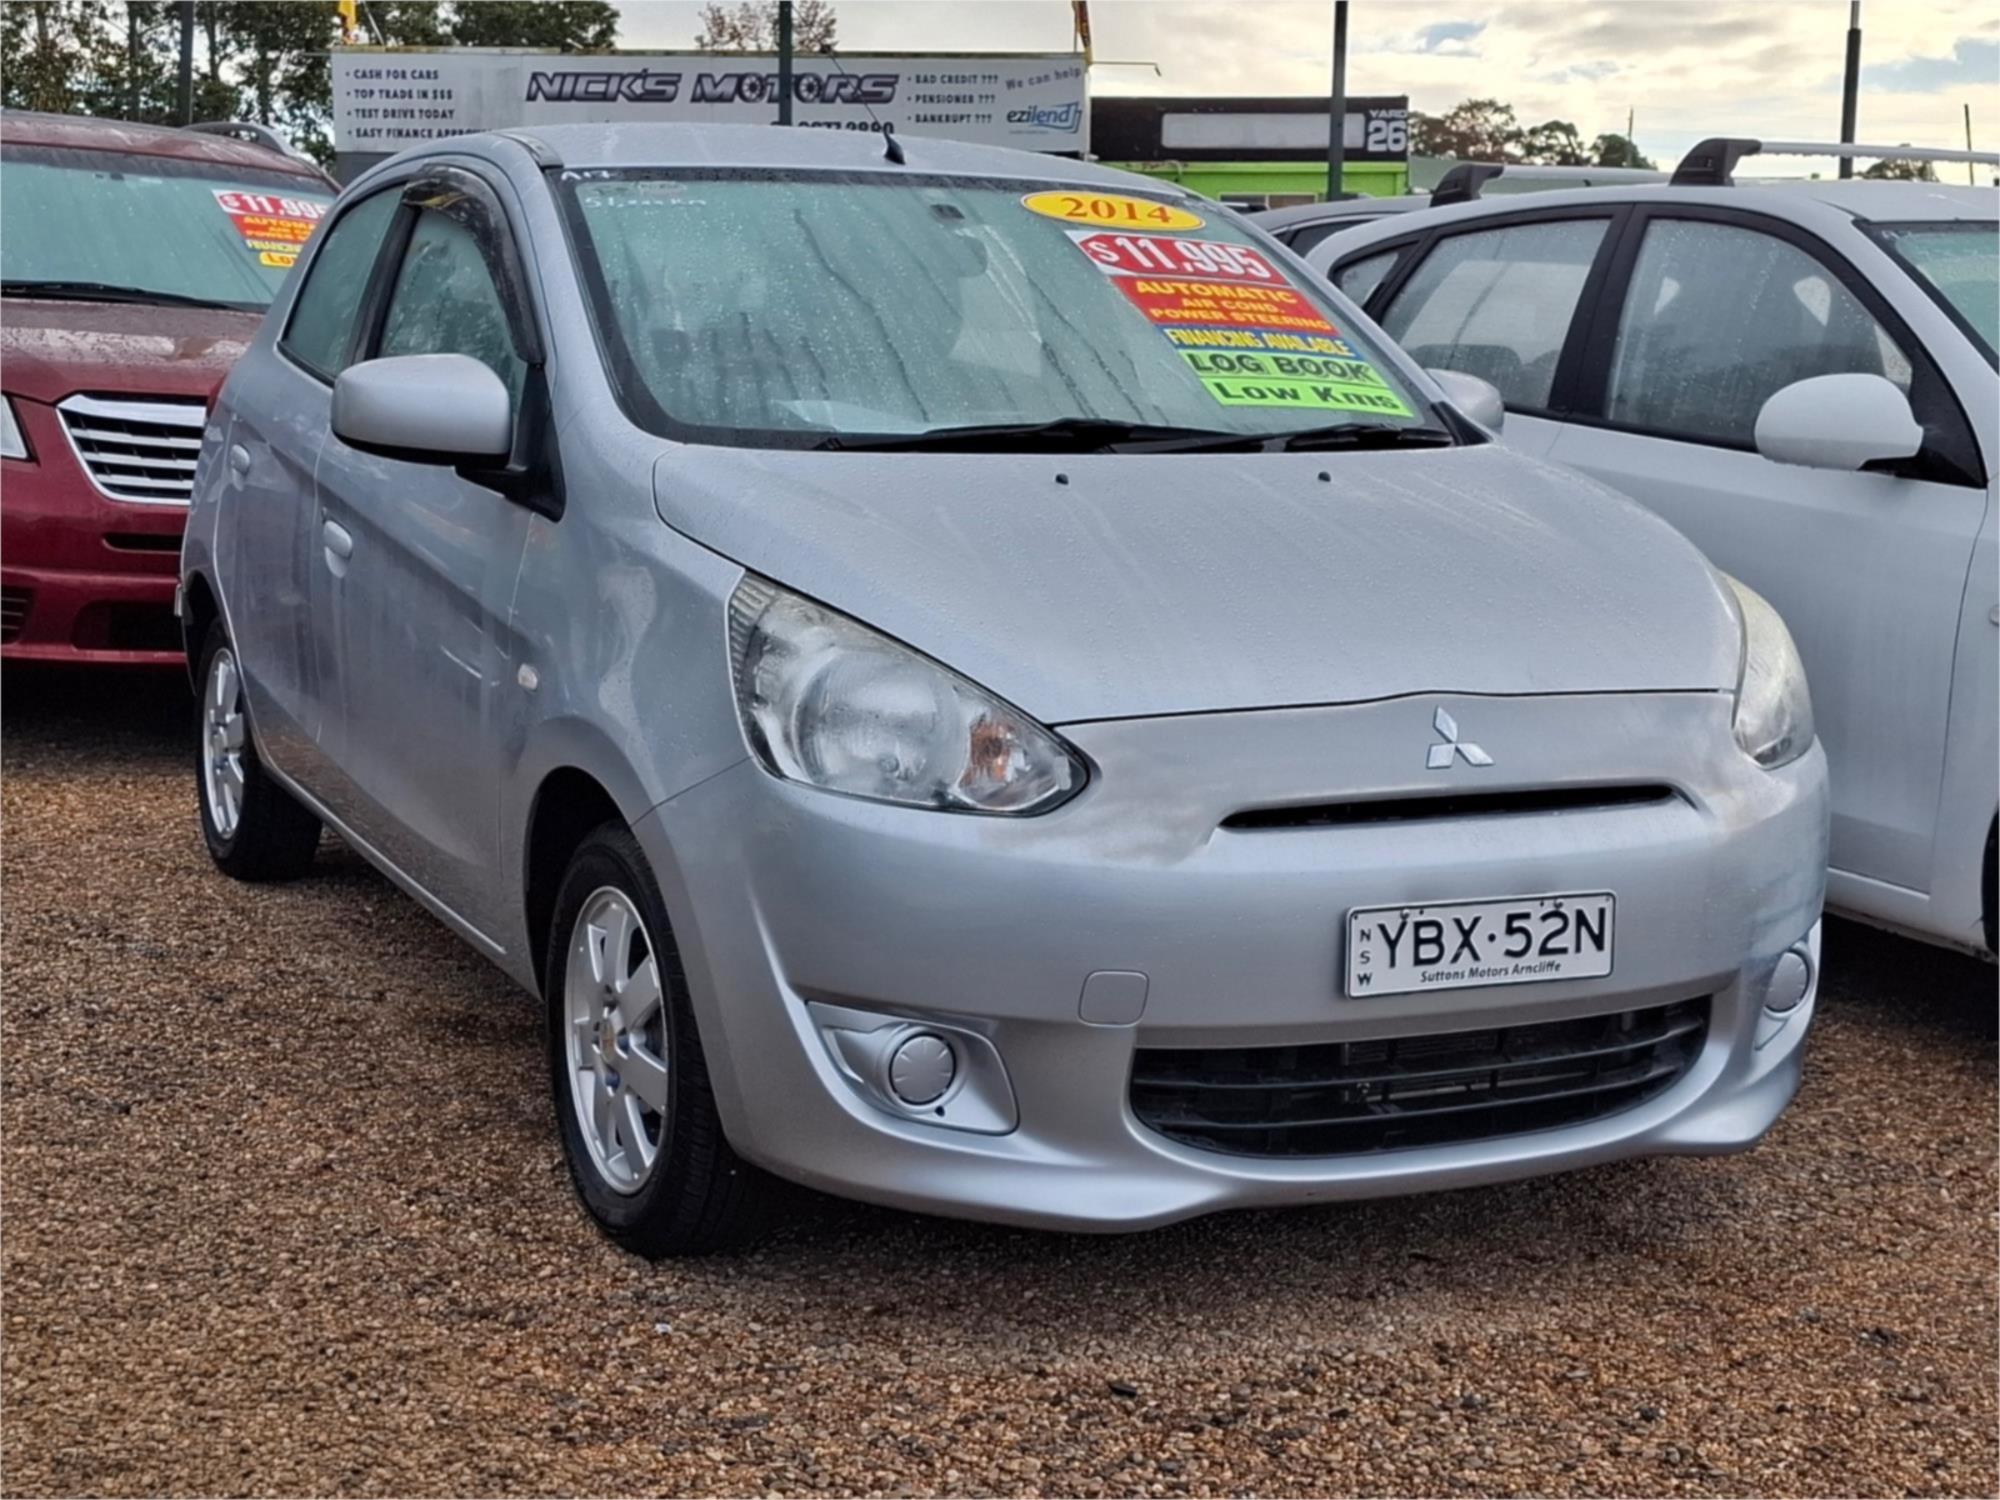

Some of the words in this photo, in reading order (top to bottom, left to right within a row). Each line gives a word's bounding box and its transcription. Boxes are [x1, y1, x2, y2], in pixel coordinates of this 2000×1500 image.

[353, 69, 382, 80] CASH
[386, 69, 407, 80] FOR
[410, 69, 439, 80] CARS
[526, 68, 682, 104] NICK'S
[915, 74, 937, 85] BAD
[940, 74, 978, 85] CREDIT
[981, 74, 998, 85] ???
[1005, 79, 1023, 90] We
[1028, 74, 1051, 86] can
[1054, 67, 1082, 81] help
[353, 89, 375, 99] TOP
[379, 89, 413, 100] TRADE
[416, 89, 429, 100] IN
[915, 94, 974, 104] PENSIONER
[978, 94, 996, 104] ???
[354, 108, 379, 119] TEST
[382, 108, 416, 119] DRIVE
[418, 108, 455, 119] TODAY
[915, 114, 971, 124] BANKRUPT
[975, 114, 992, 124] ???
[1006, 103, 1071, 124] ezilend
[1368, 109, 1407, 119] YARD
[355, 127, 383, 138] EASY
[386, 128, 433, 139] FINANCE
[1367, 119, 1407, 152] 26
[1065, 197, 1172, 225] 2014
[1087, 236, 1272, 279] $11,995
[1136, 281, 1298, 304] AUTOMATIC
[1181, 298, 1218, 309] AIR
[1222, 300, 1285, 313] COND.
[1149, 308, 1229, 321] POWER
[1231, 311, 1333, 331] STEERING
[1163, 328, 1265, 348] FINANCING
[1262, 332, 1357, 357] AVAILABLE
[1186, 352, 1266, 374] LOG
[1271, 356, 1382, 385] BOOK
[1213, 381, 1301, 401] Low
[1310, 386, 1401, 410] Kms
[1420, 968, 1465, 983] Suttons
[1468, 966, 1509, 979] Motors
[1511, 960, 1562, 975] Arncliffe
